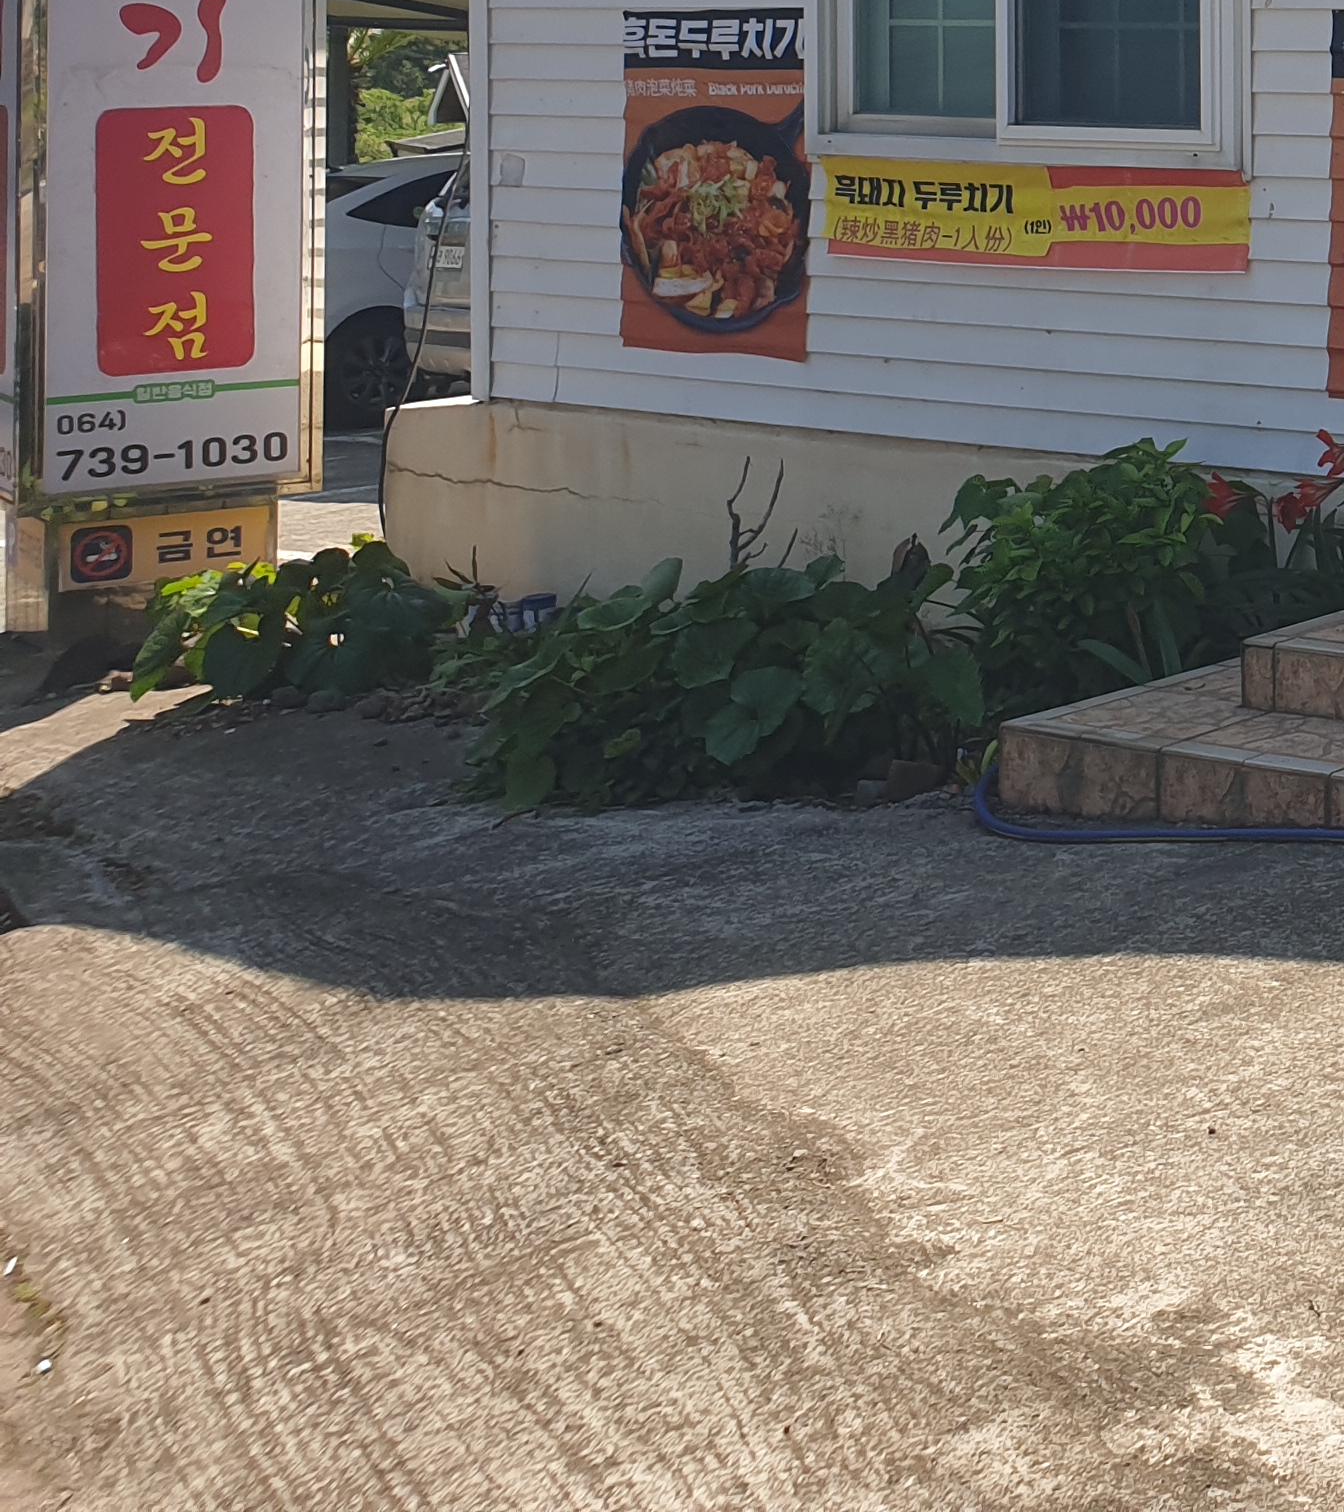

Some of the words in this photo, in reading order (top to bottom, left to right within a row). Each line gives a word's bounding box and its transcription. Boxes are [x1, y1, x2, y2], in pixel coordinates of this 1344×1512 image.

[708, 82, 738, 96] Black
[834, 174, 906, 209] 흑돼지
[912, 180, 1015, 215] 두루치기
[1024, 219, 1053, 236] (1인)
[1059, 195, 1202, 236] ₩10,000
[140, 117, 213, 361] 전문점
[56, 409, 127, 436] 064)
[56, 431, 289, 482] 739-1030
[156, 524, 243, 565] 금연
